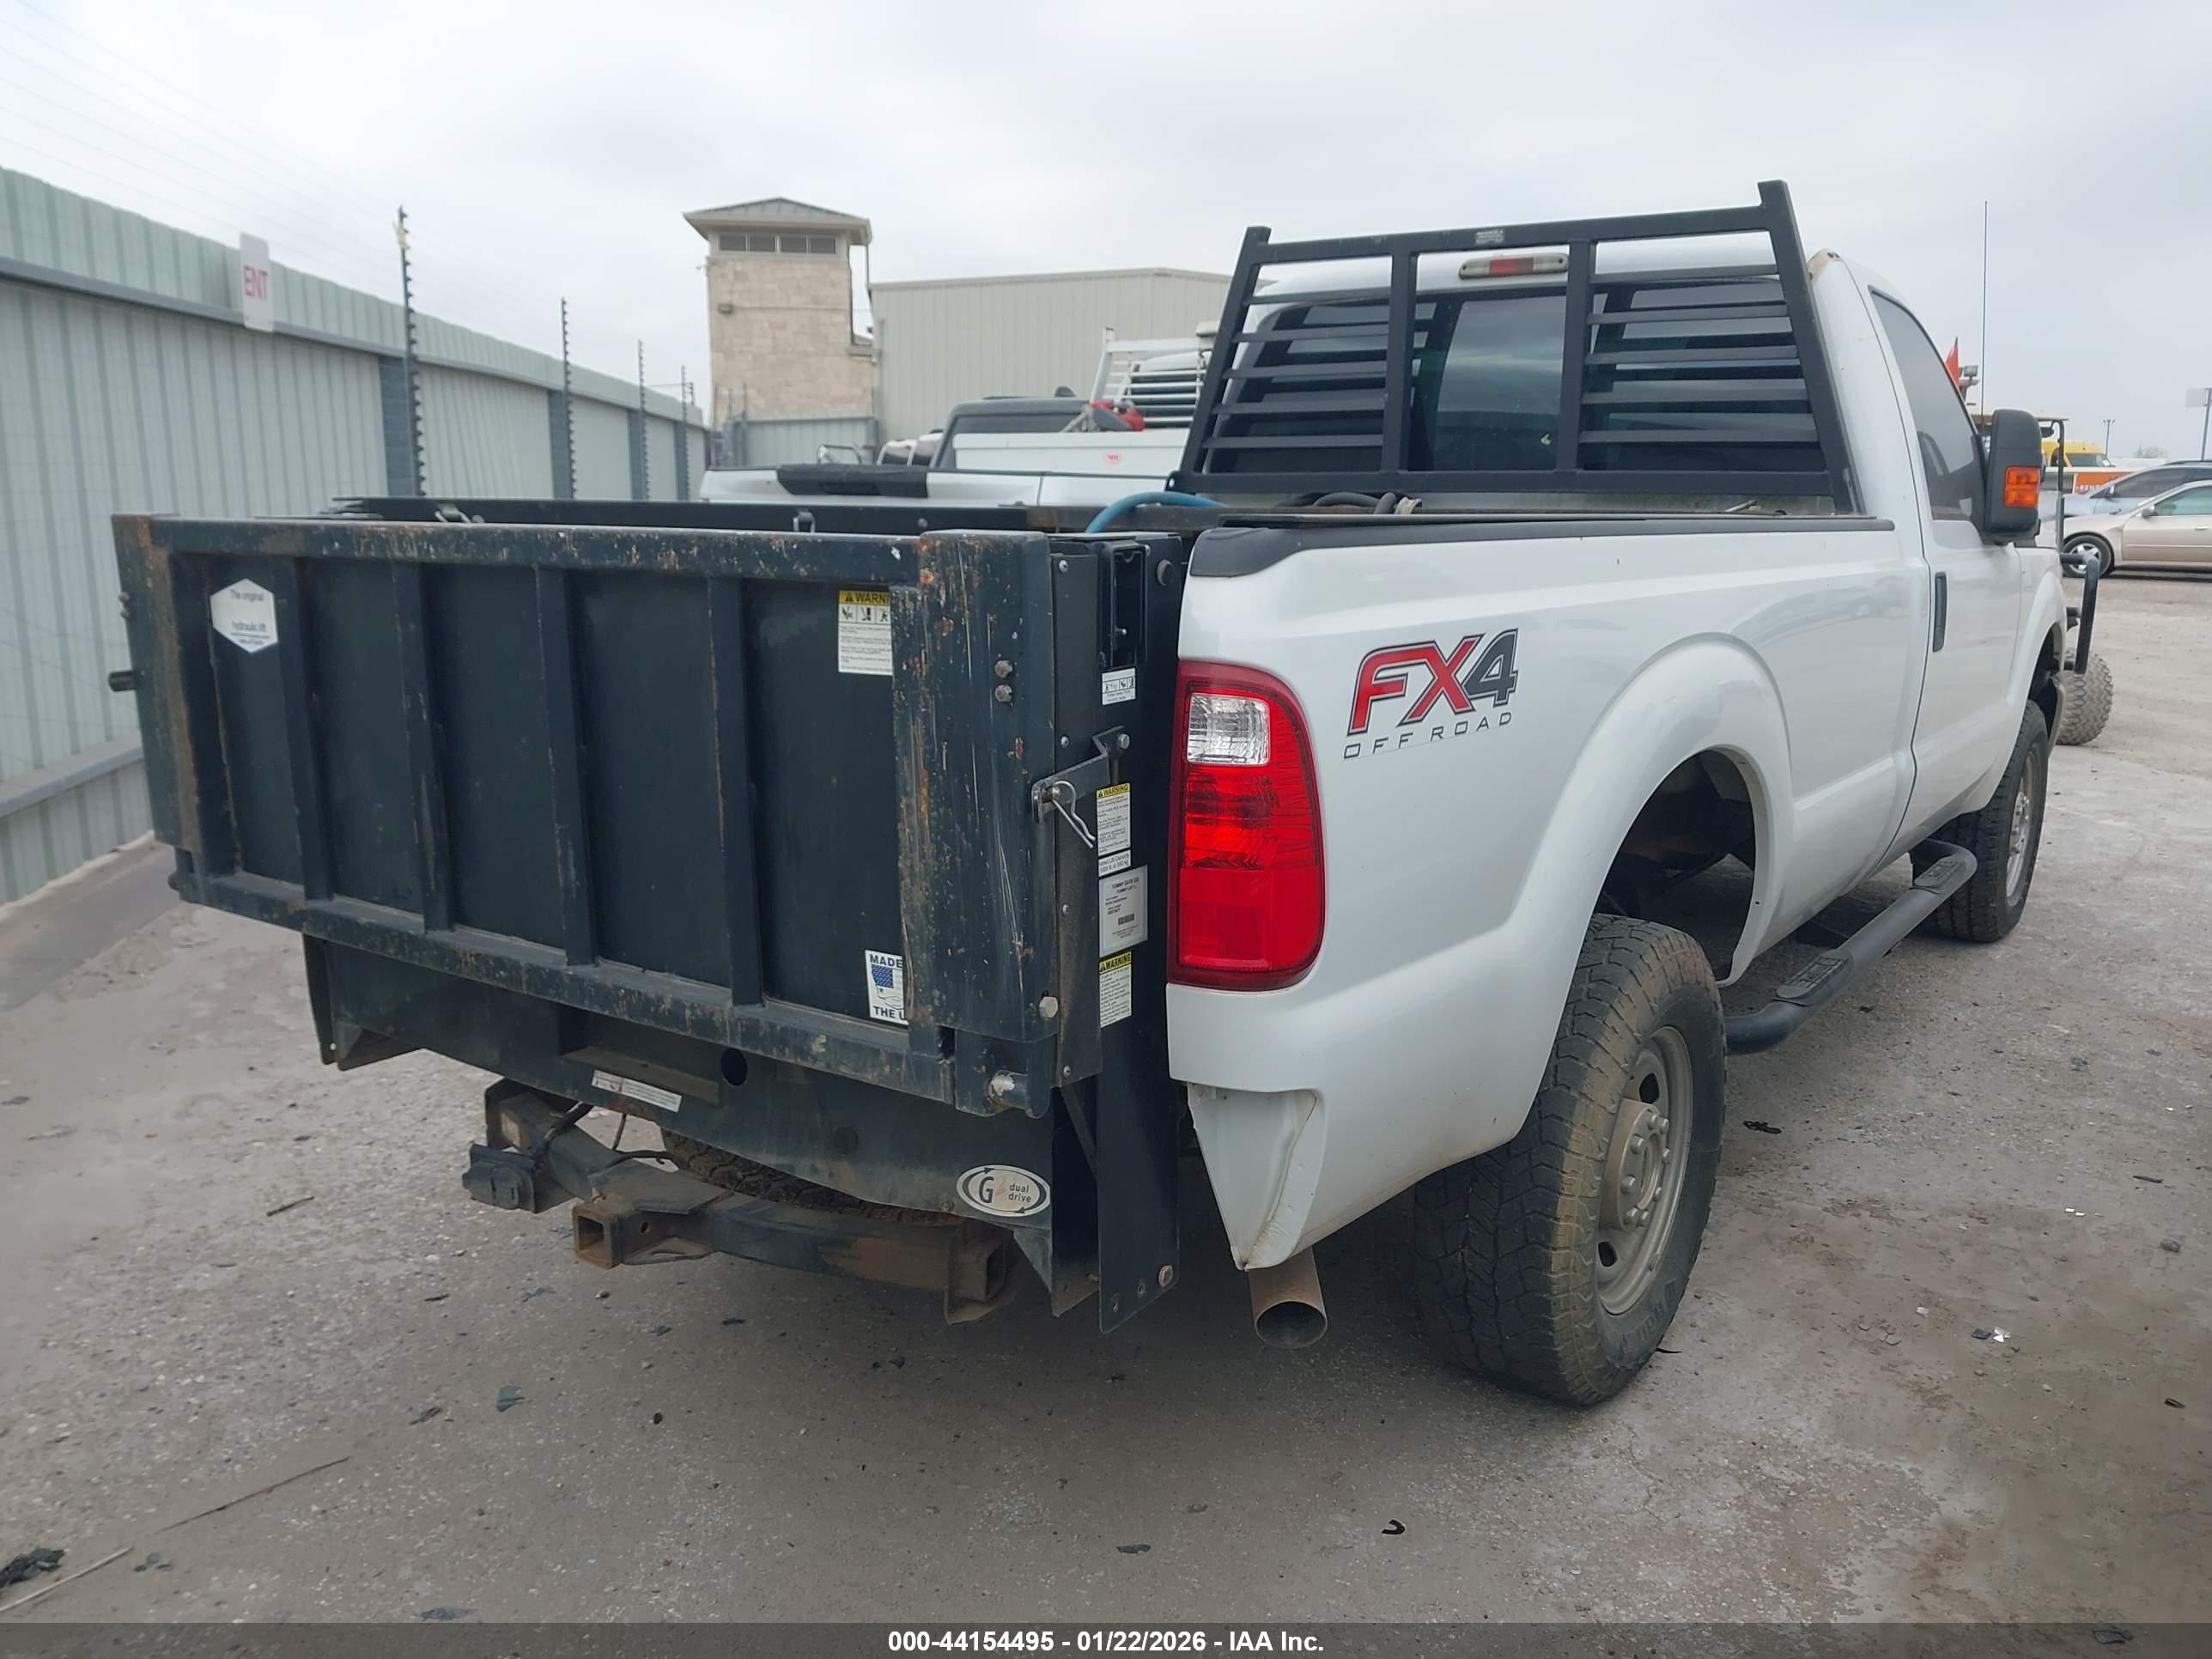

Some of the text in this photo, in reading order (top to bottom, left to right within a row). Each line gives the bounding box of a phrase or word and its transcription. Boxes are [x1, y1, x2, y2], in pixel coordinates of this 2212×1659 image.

[1347, 628, 1518, 736] FX4
[1344, 712, 1511, 759] OFF ROAD
[869, 954, 903, 969] MADE
[1105, 953, 1131, 969] WARNING
[873, 1006, 896, 1018] THE
[1010, 1183, 1030, 1193] dual
[1008, 1192, 1031, 1203] drive
